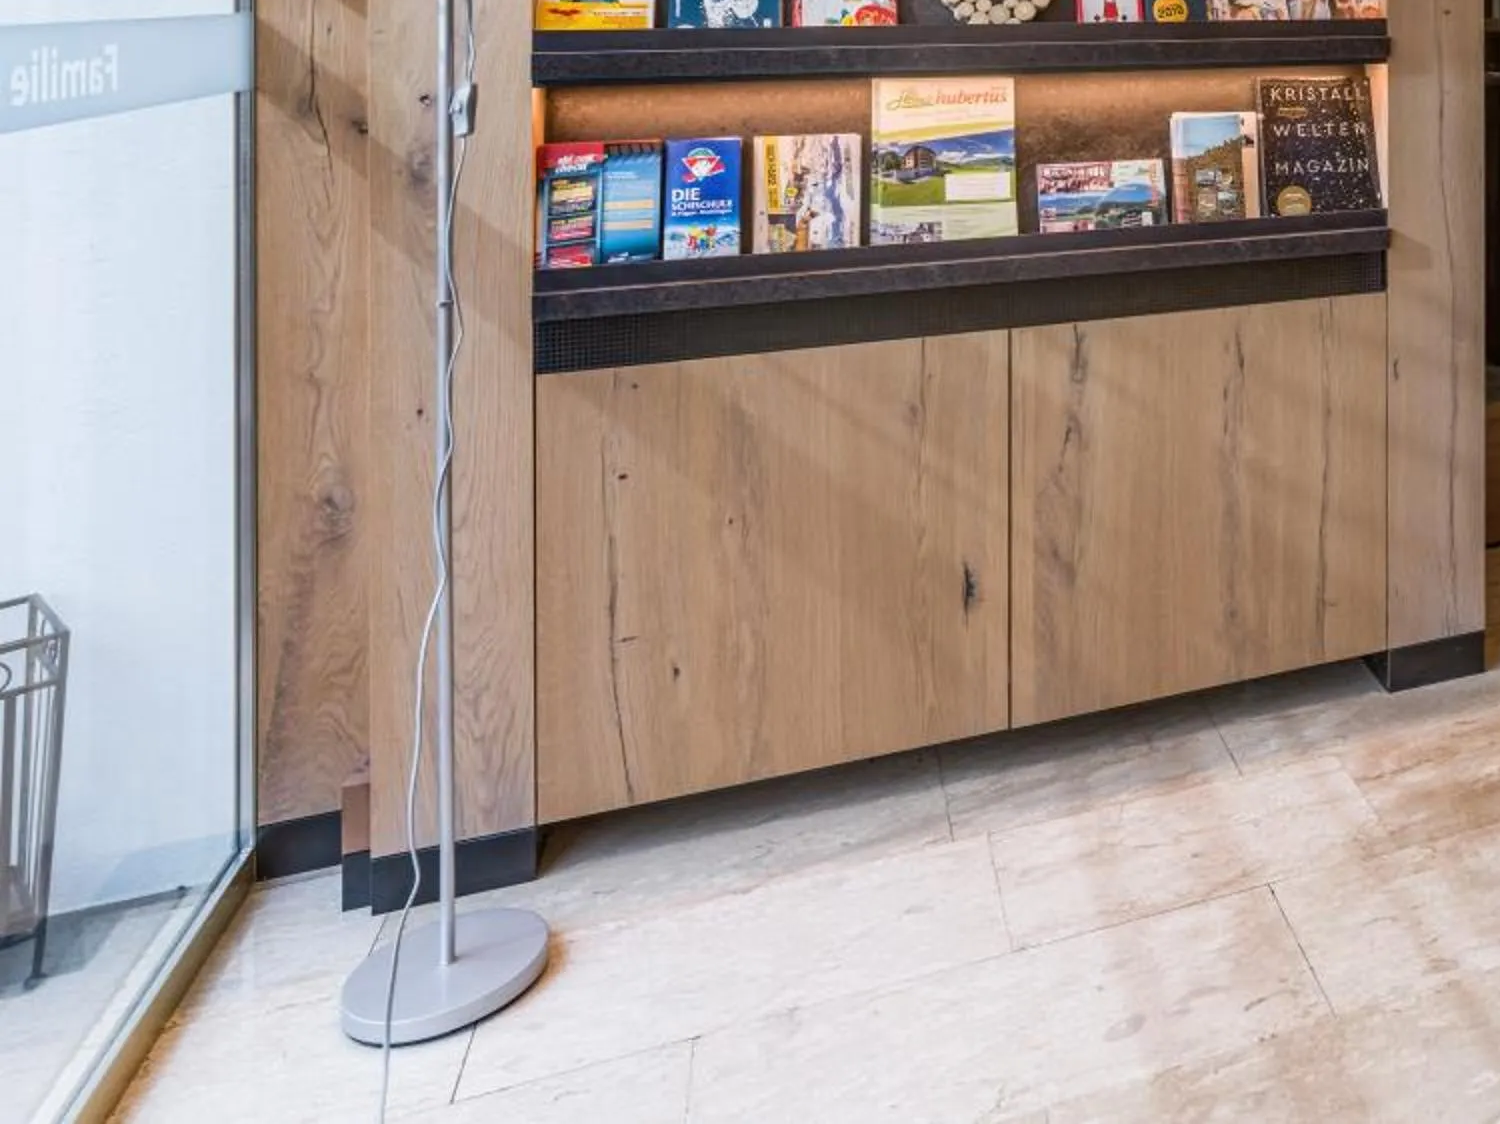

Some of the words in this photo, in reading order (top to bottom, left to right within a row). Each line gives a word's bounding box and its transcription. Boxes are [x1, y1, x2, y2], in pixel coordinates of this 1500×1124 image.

[936, 87, 1008, 106] hubertus
[1269, 83, 1366, 102] KRISTALL
[1272, 121, 1367, 138] WELTEN
[1274, 156, 1370, 177] MAGAZIN
[671, 187, 701, 201] DIE
